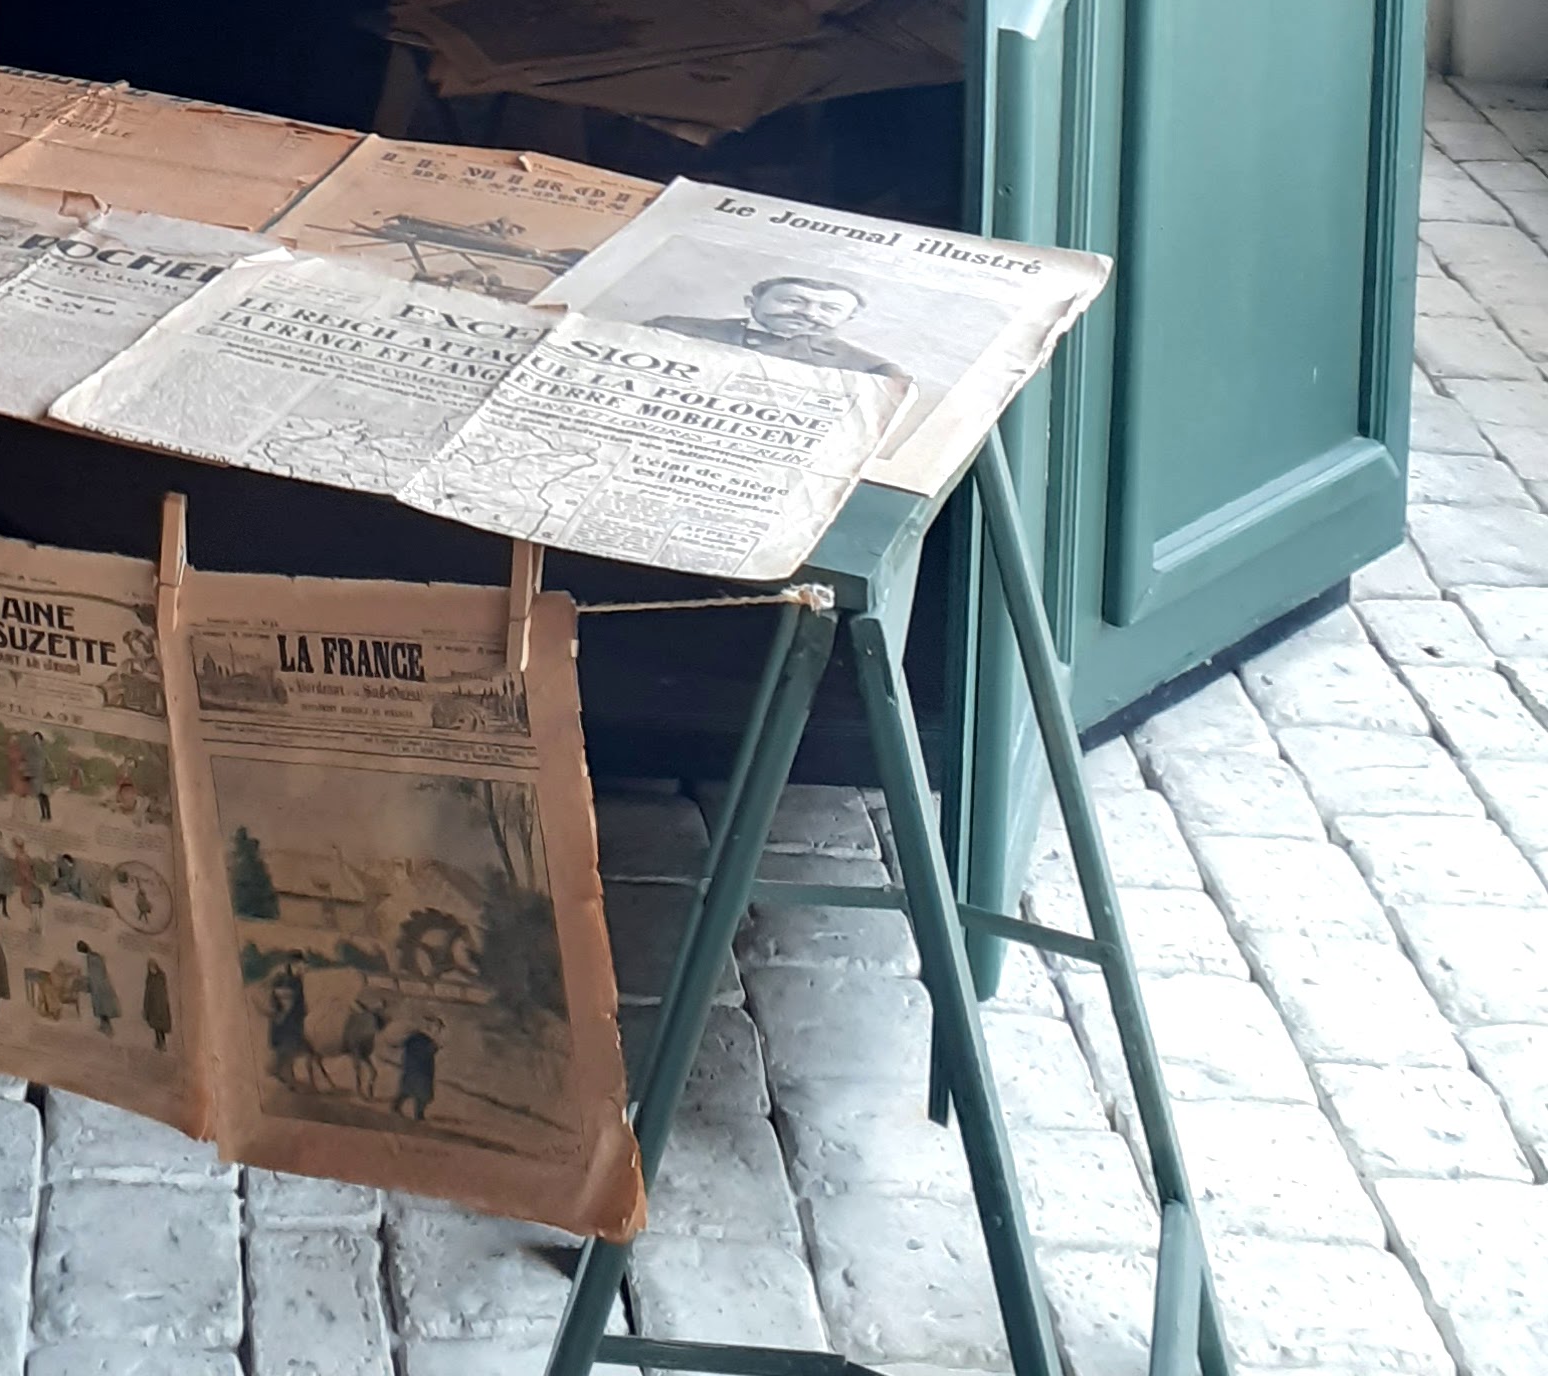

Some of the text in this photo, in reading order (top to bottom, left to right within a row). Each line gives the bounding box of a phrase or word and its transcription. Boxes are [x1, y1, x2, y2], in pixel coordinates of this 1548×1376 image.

[712, 195, 1045, 277] Le Journal illustré
[218, 312, 254, 329] LA
[260, 320, 370, 354] FRANCE
[381, 344, 414, 360] ET
[635, 400, 825, 451] MOBILISENT
[237, 298, 275, 320] LE
[294, 306, 399, 342] REICH
[588, 372, 638, 393] LA
[654, 384, 833, 434] POLOGNE
[693, 465, 725, 482] de
[276, 633, 429, 683] LA FRANCE
